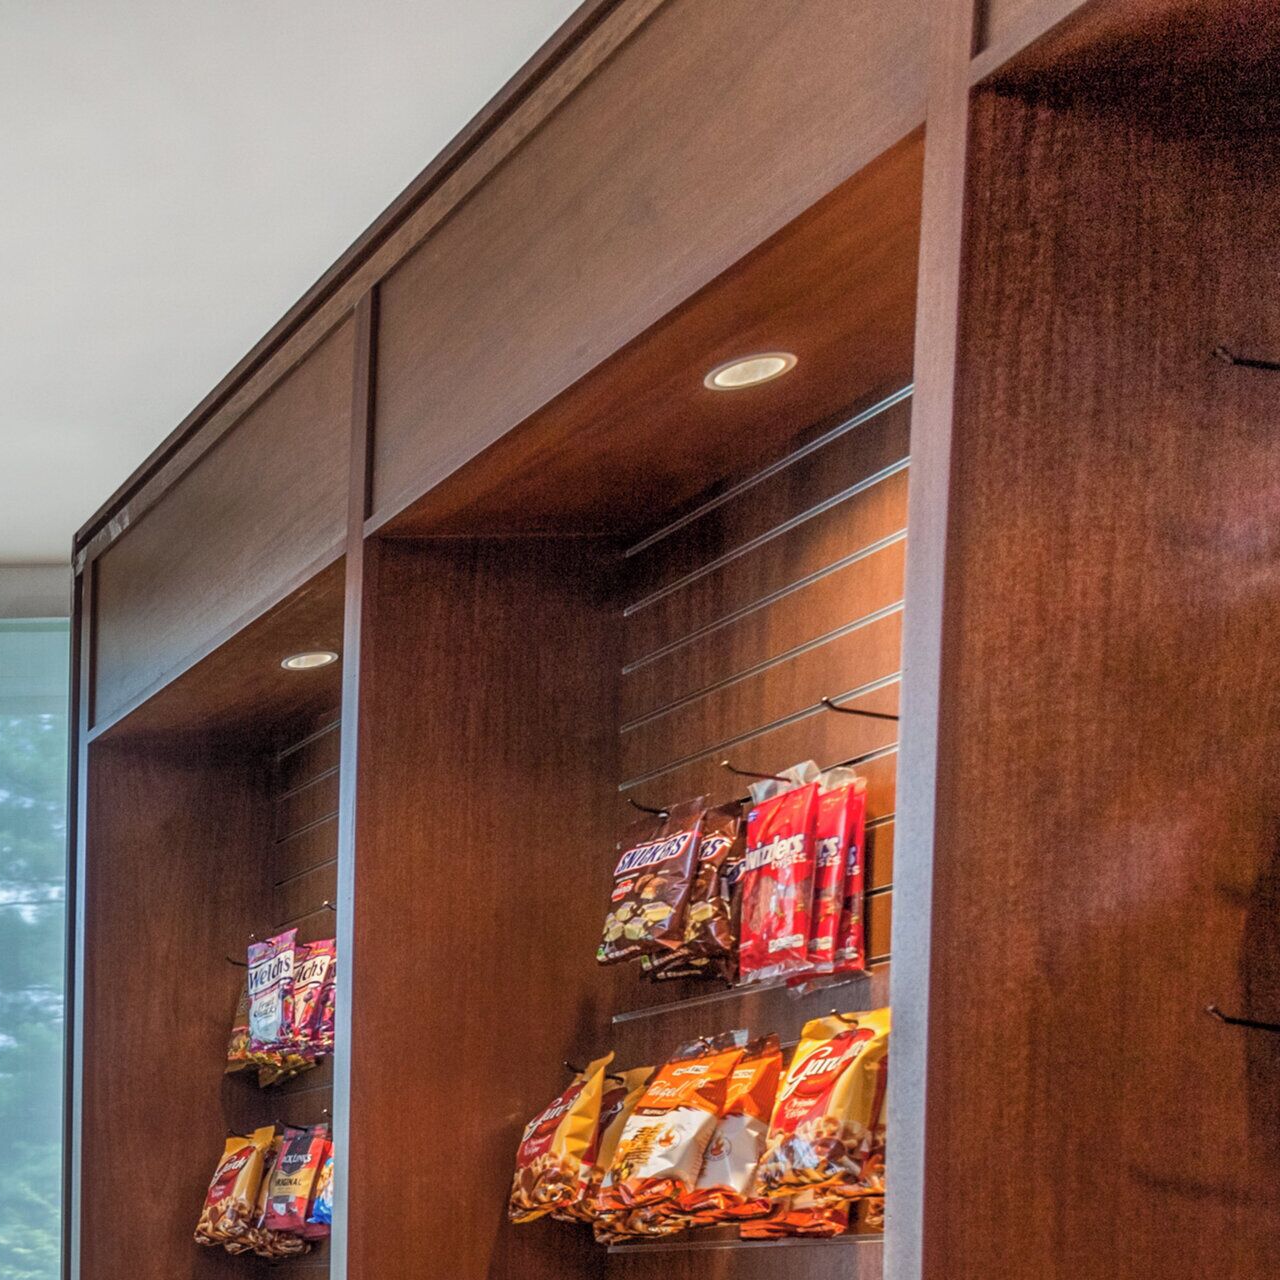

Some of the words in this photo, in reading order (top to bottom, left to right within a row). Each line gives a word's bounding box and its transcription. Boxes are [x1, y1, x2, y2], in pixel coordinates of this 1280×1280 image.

[616, 834, 688, 874] SNICKERS
[746, 833, 804, 871] wizzlers
[249, 956, 290, 990] Welch's
